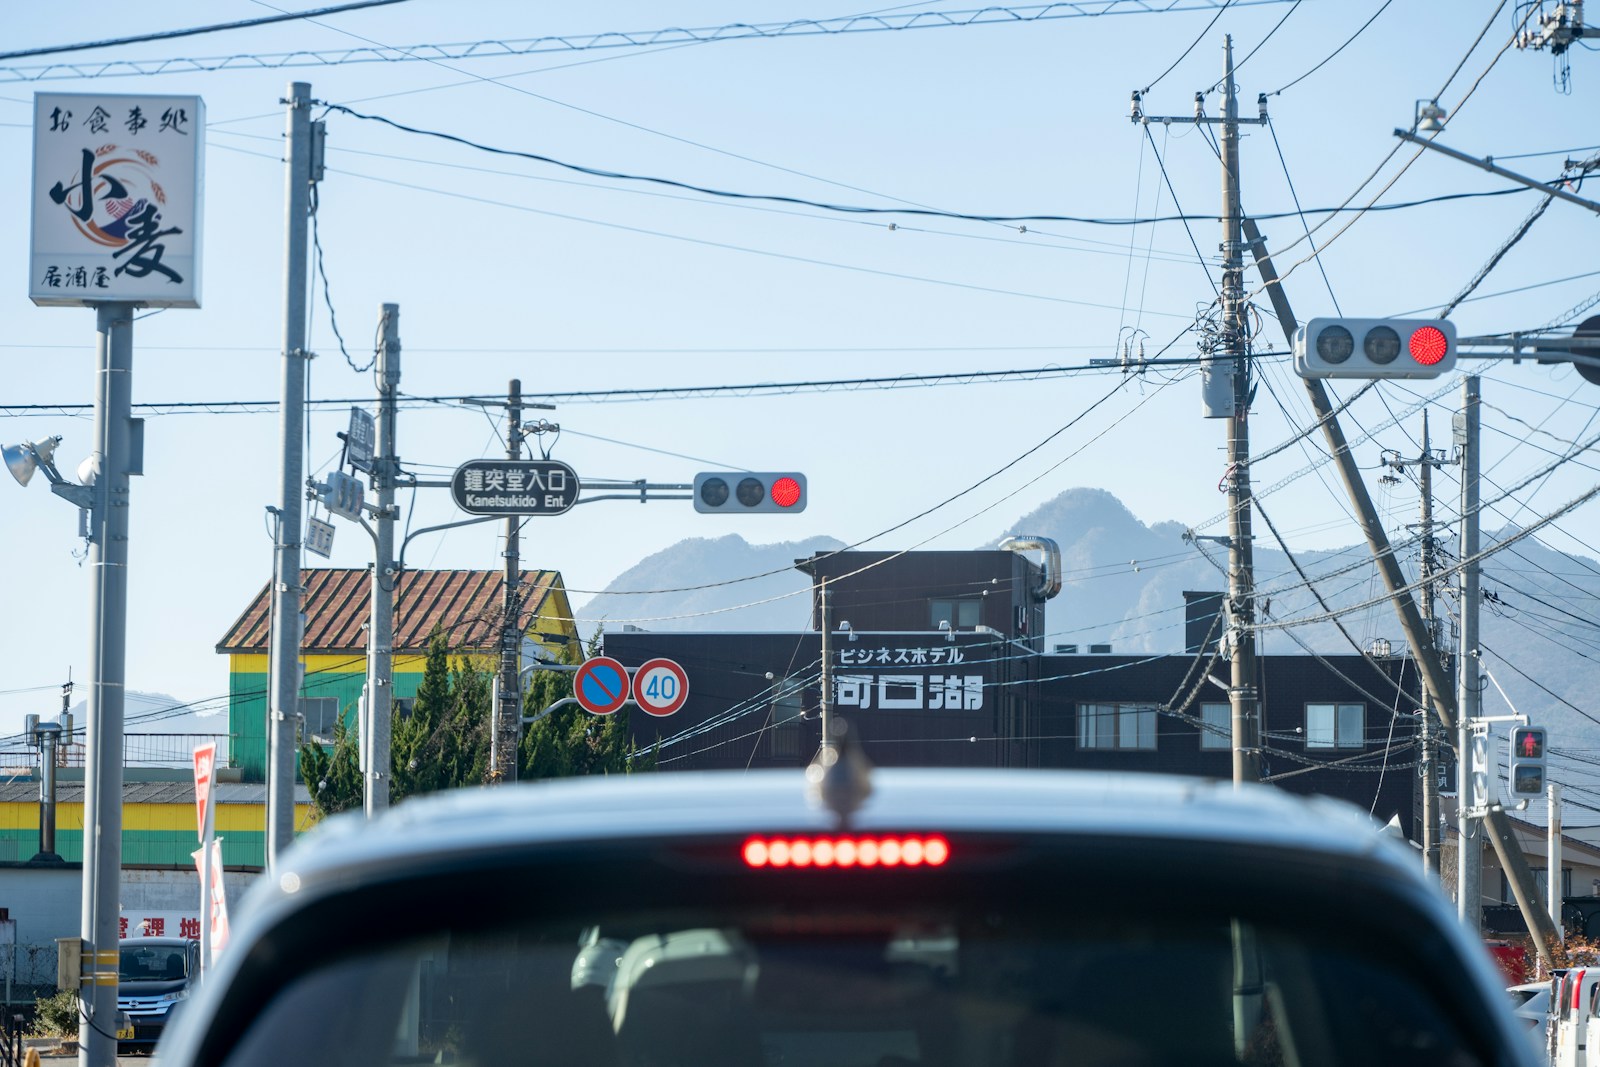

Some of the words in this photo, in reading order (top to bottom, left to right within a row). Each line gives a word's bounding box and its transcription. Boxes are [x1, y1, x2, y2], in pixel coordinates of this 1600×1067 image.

[50, 105, 188, 136] お食事処
[50, 148, 184, 284] 小麦
[41, 265, 111, 288] 居酒屋
[463, 469, 566, 492] 鐘突堂入口
[465, 494, 537, 508] Kanetsukido
[544, 494, 568, 508] Ent.
[840, 646, 964, 664] ビジネスホテル
[646, 675, 676, 700] 40
